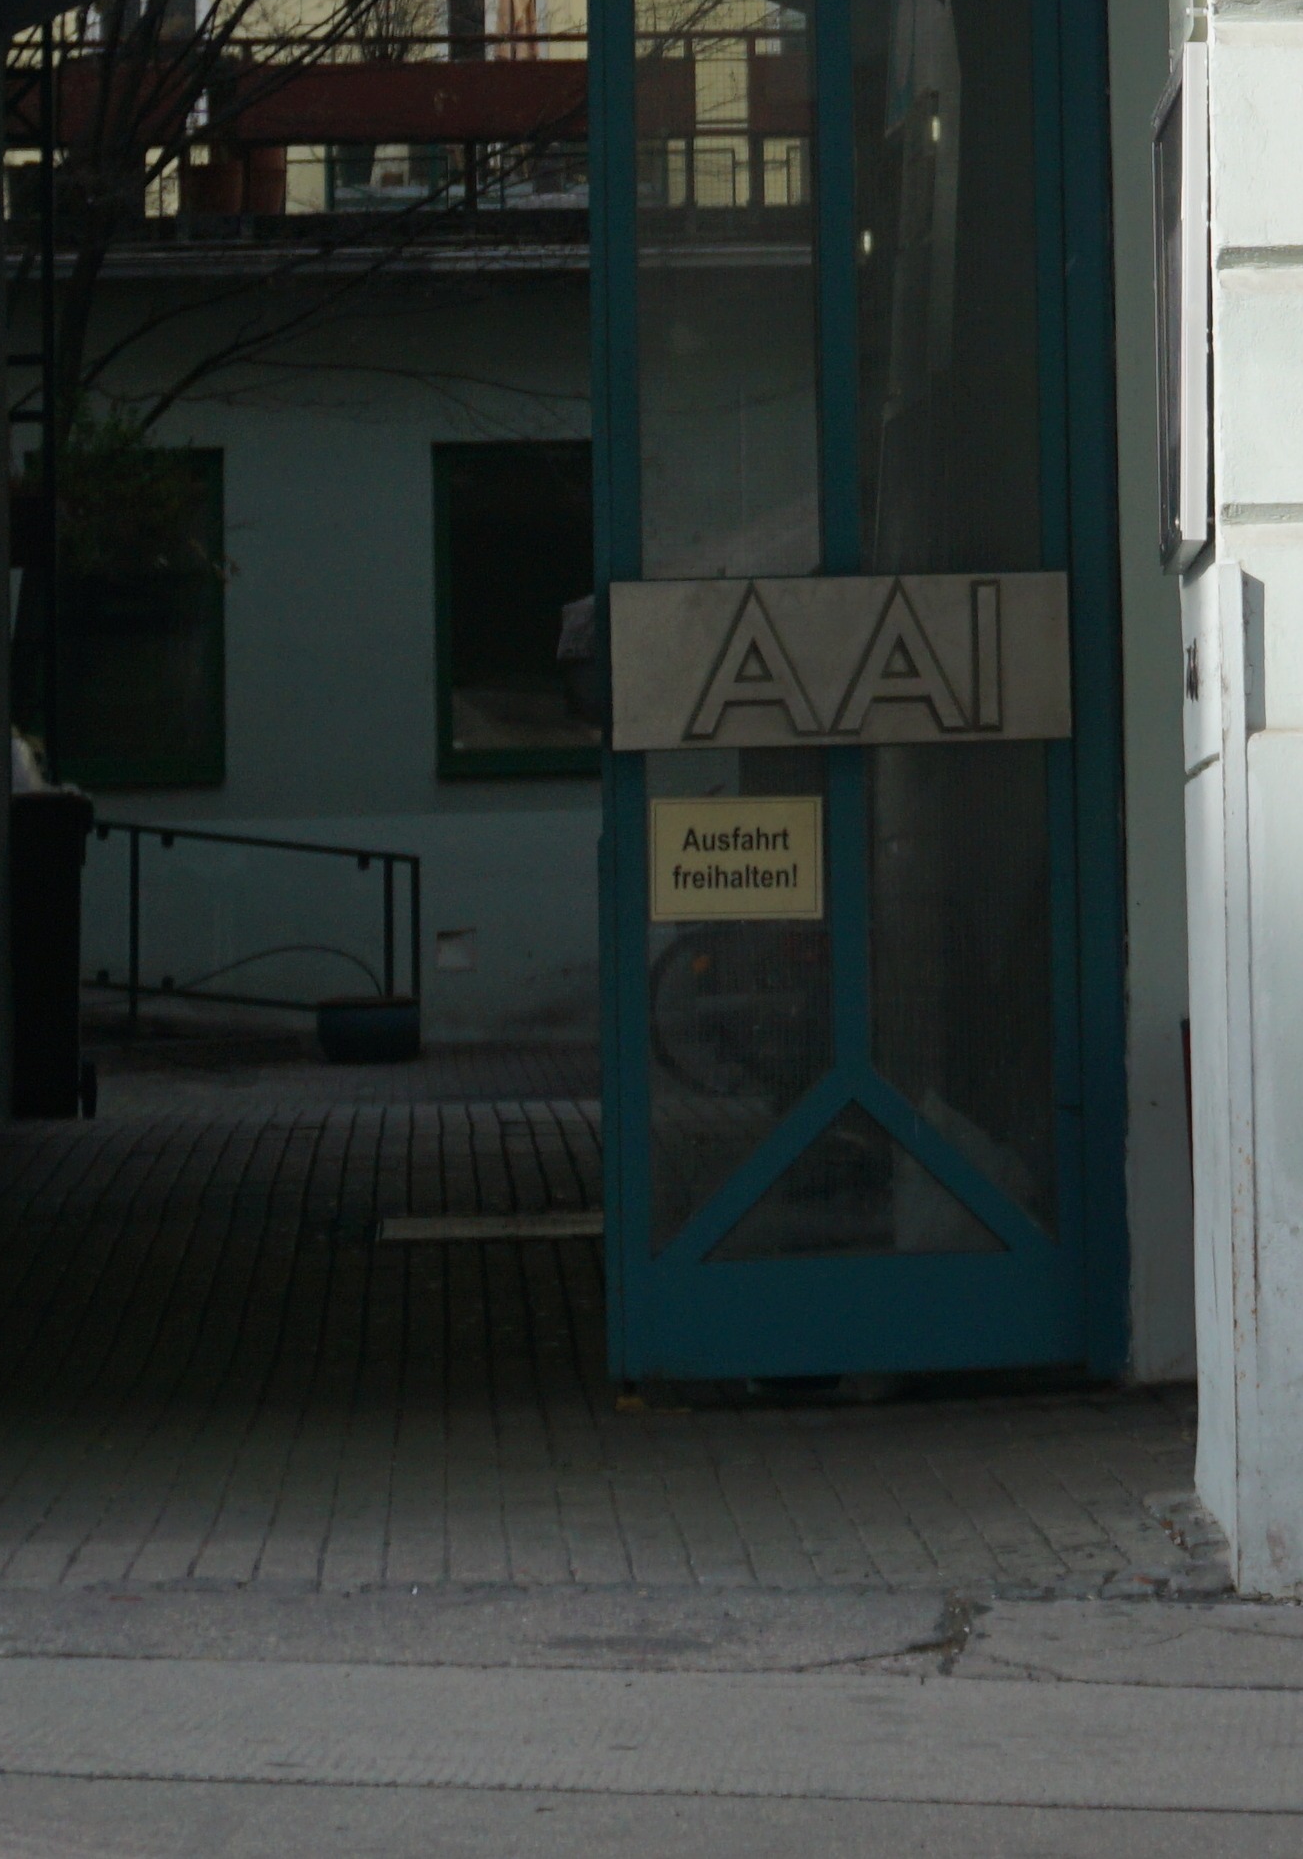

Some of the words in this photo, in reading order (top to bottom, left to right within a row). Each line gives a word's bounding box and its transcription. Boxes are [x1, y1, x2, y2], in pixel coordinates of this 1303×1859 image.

[681, 577, 1005, 742] AAI
[681, 826, 791, 854] Ausfahrt
[672, 862, 799, 891] freihalten!
